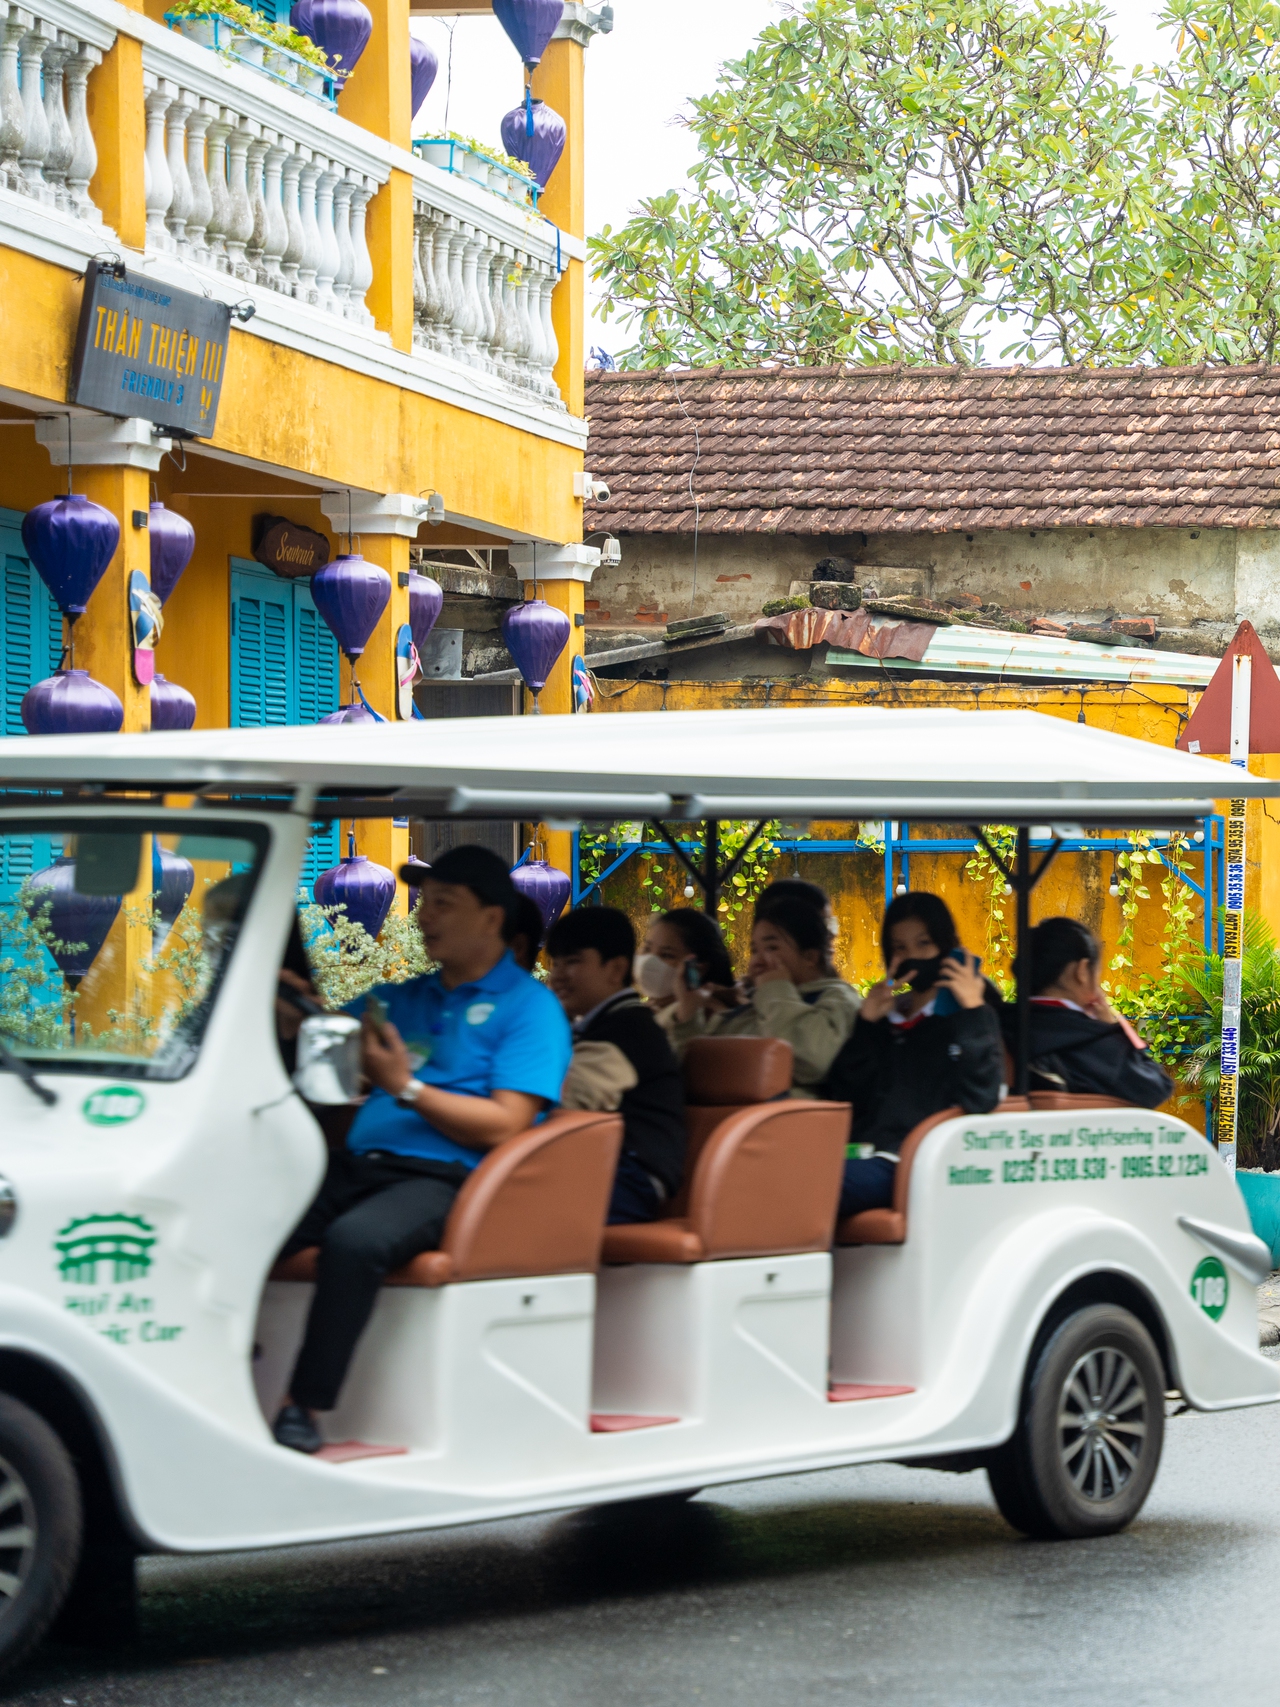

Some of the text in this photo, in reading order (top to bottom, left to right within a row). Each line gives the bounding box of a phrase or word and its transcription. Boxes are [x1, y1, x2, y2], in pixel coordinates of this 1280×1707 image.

[148, 323, 199, 379] THIỆN
[121, 369, 184, 406] FRIENDLY 3
[276, 531, 315, 566] Souvenir
[1049, 1128, 1073, 1147] and
[1157, 1126, 1187, 1144] Tour
